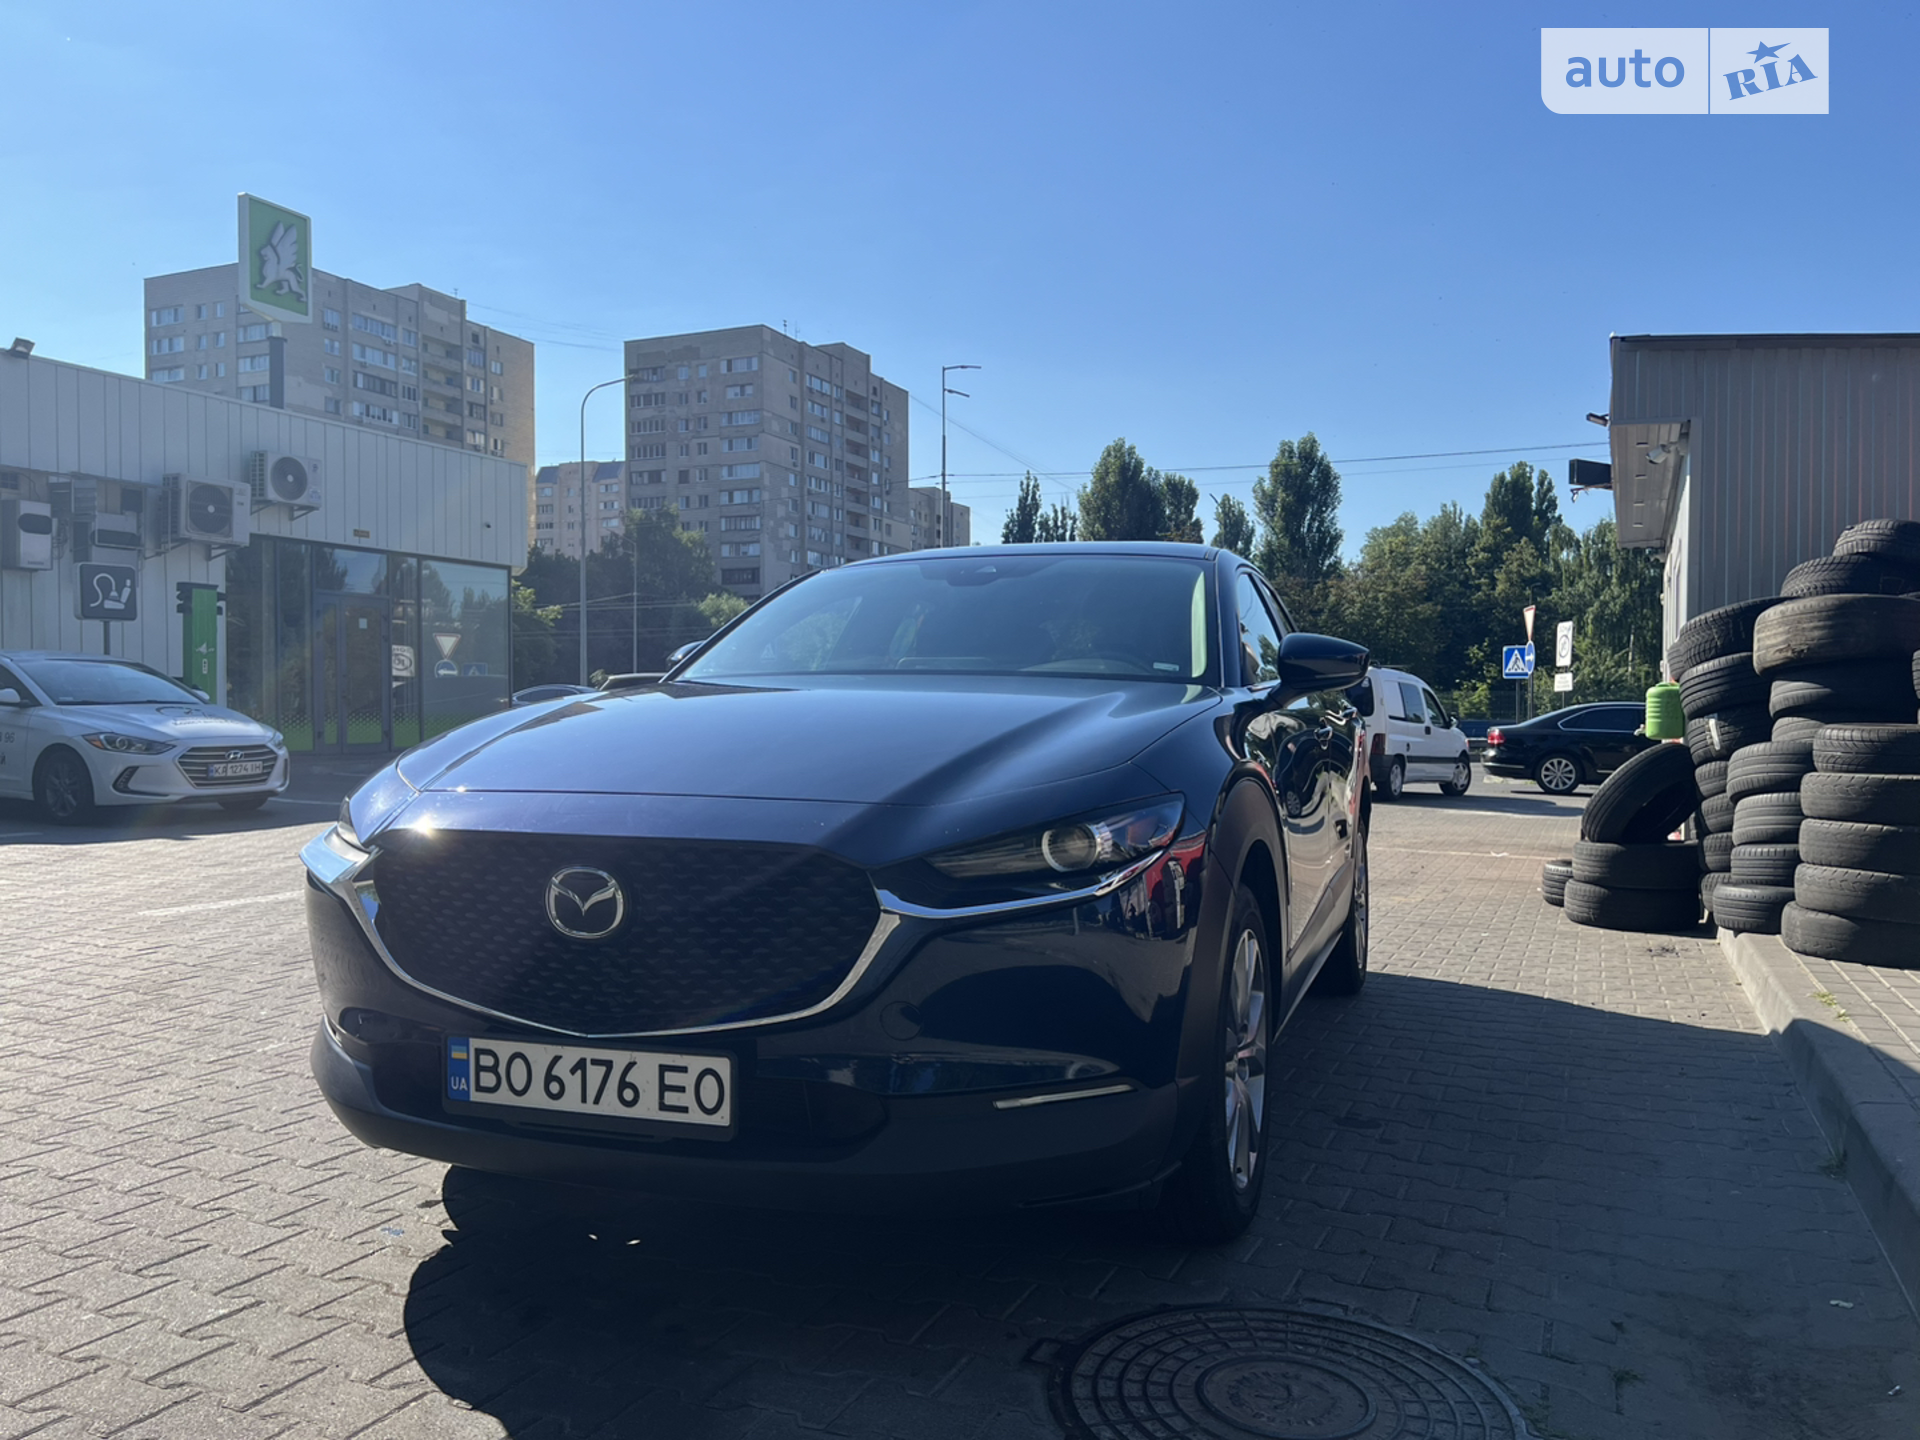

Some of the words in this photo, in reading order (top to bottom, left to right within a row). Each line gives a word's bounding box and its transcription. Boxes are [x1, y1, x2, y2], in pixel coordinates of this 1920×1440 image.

[450, 1076, 468, 1092] UA
[473, 1047, 533, 1098] BO
[542, 1055, 641, 1108] 6176
[657, 1063, 725, 1116] EO
